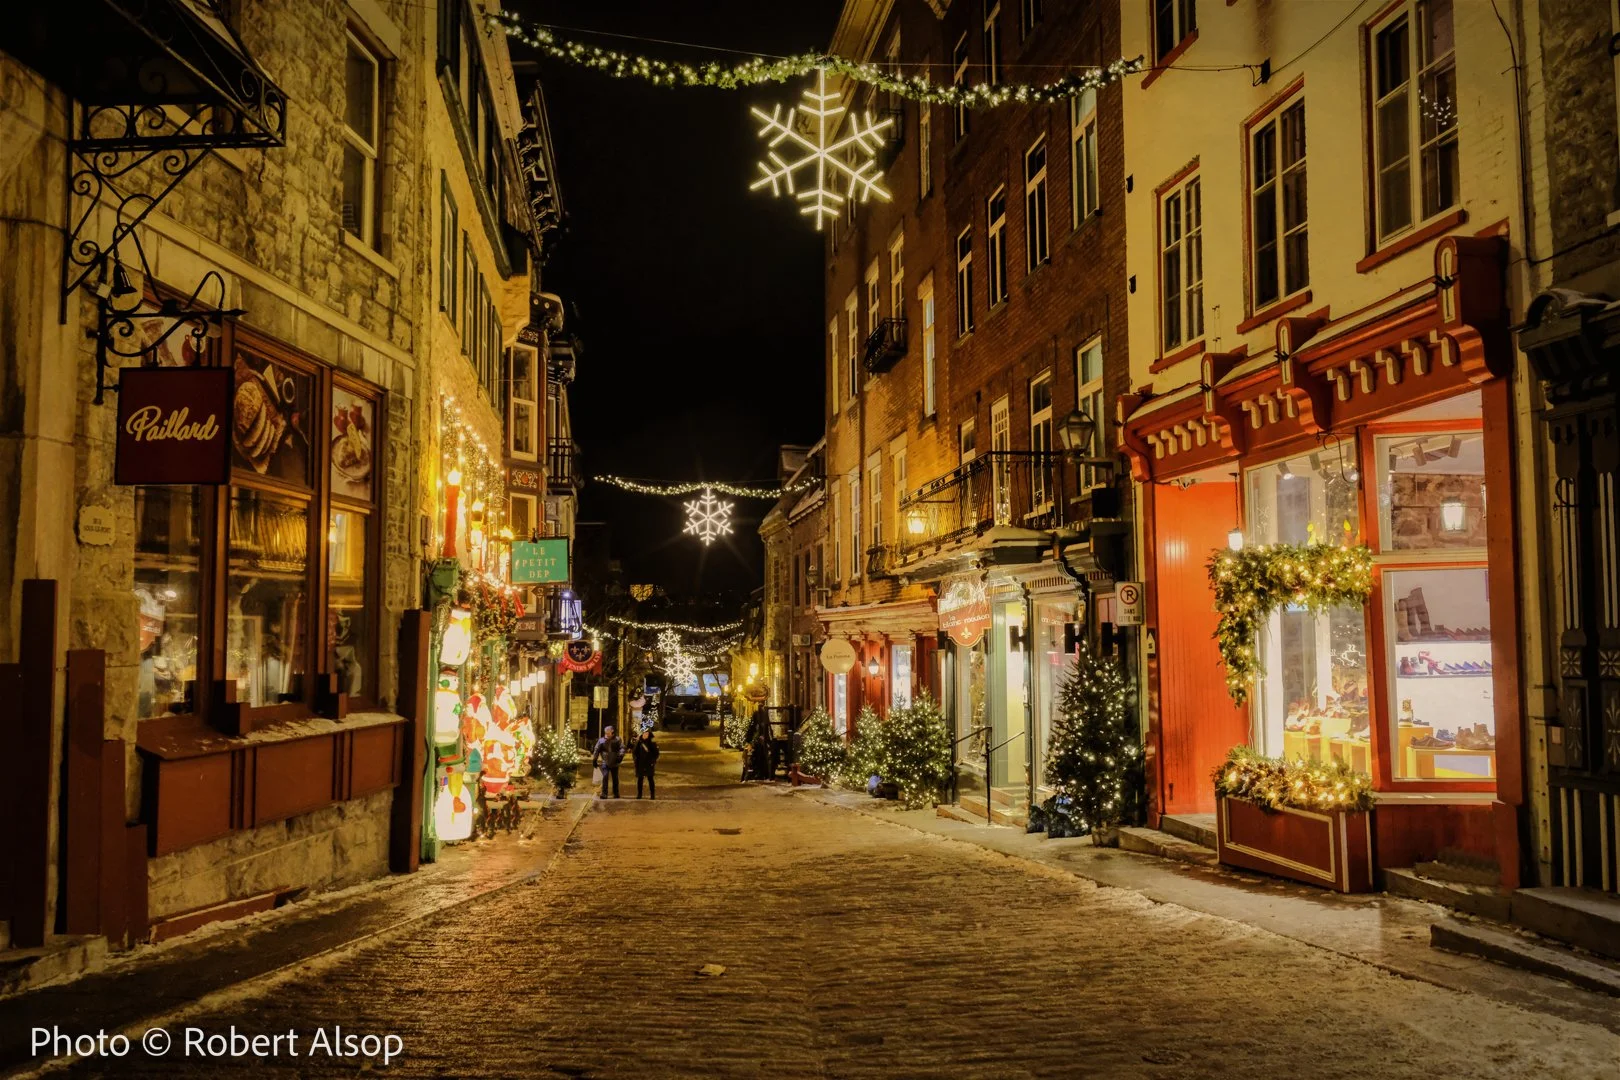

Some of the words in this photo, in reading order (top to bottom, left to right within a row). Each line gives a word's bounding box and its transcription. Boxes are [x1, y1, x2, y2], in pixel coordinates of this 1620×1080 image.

[126, 405, 220, 441] Paillard
[533, 547, 546, 558] LE
[522, 558, 557, 569] PETIT
[529, 569, 551, 579] DEP
